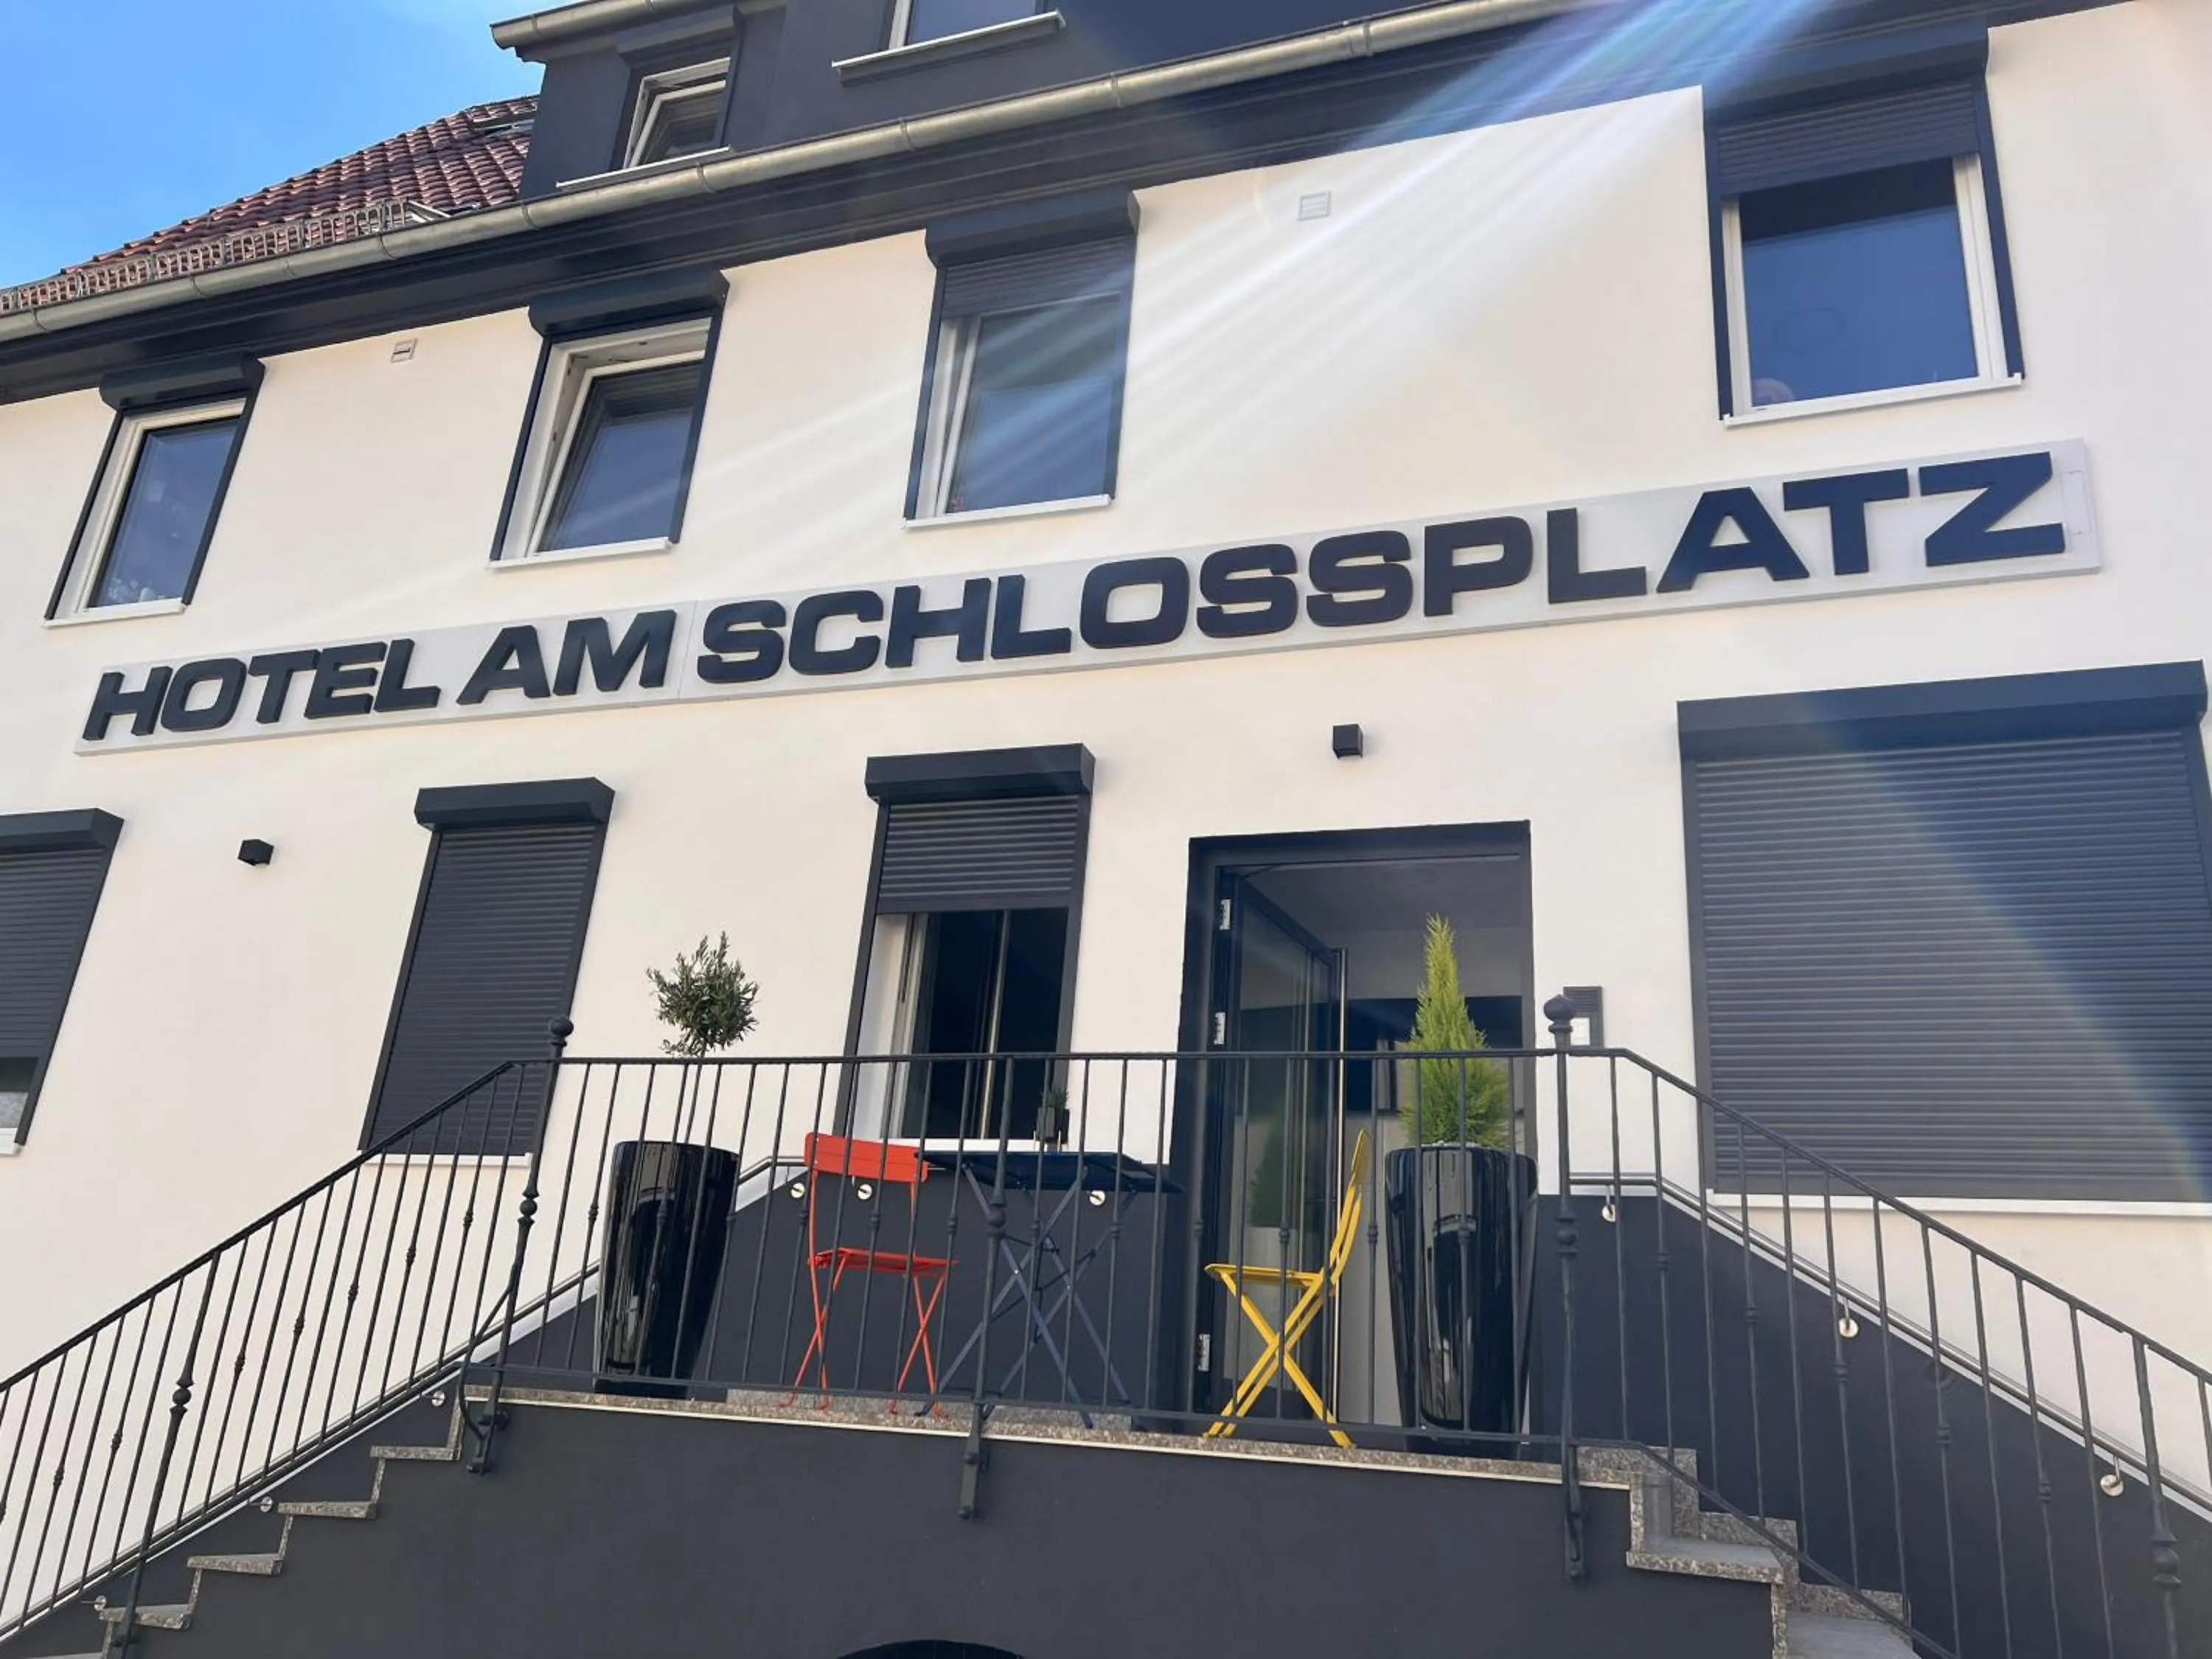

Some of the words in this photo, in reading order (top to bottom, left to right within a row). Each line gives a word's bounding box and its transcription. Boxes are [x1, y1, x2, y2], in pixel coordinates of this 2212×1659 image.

[82, 639, 442, 741] HOTEL
[456, 610, 677, 706] AM
[697, 451, 2065, 684] SCHLOSSPLATZ
